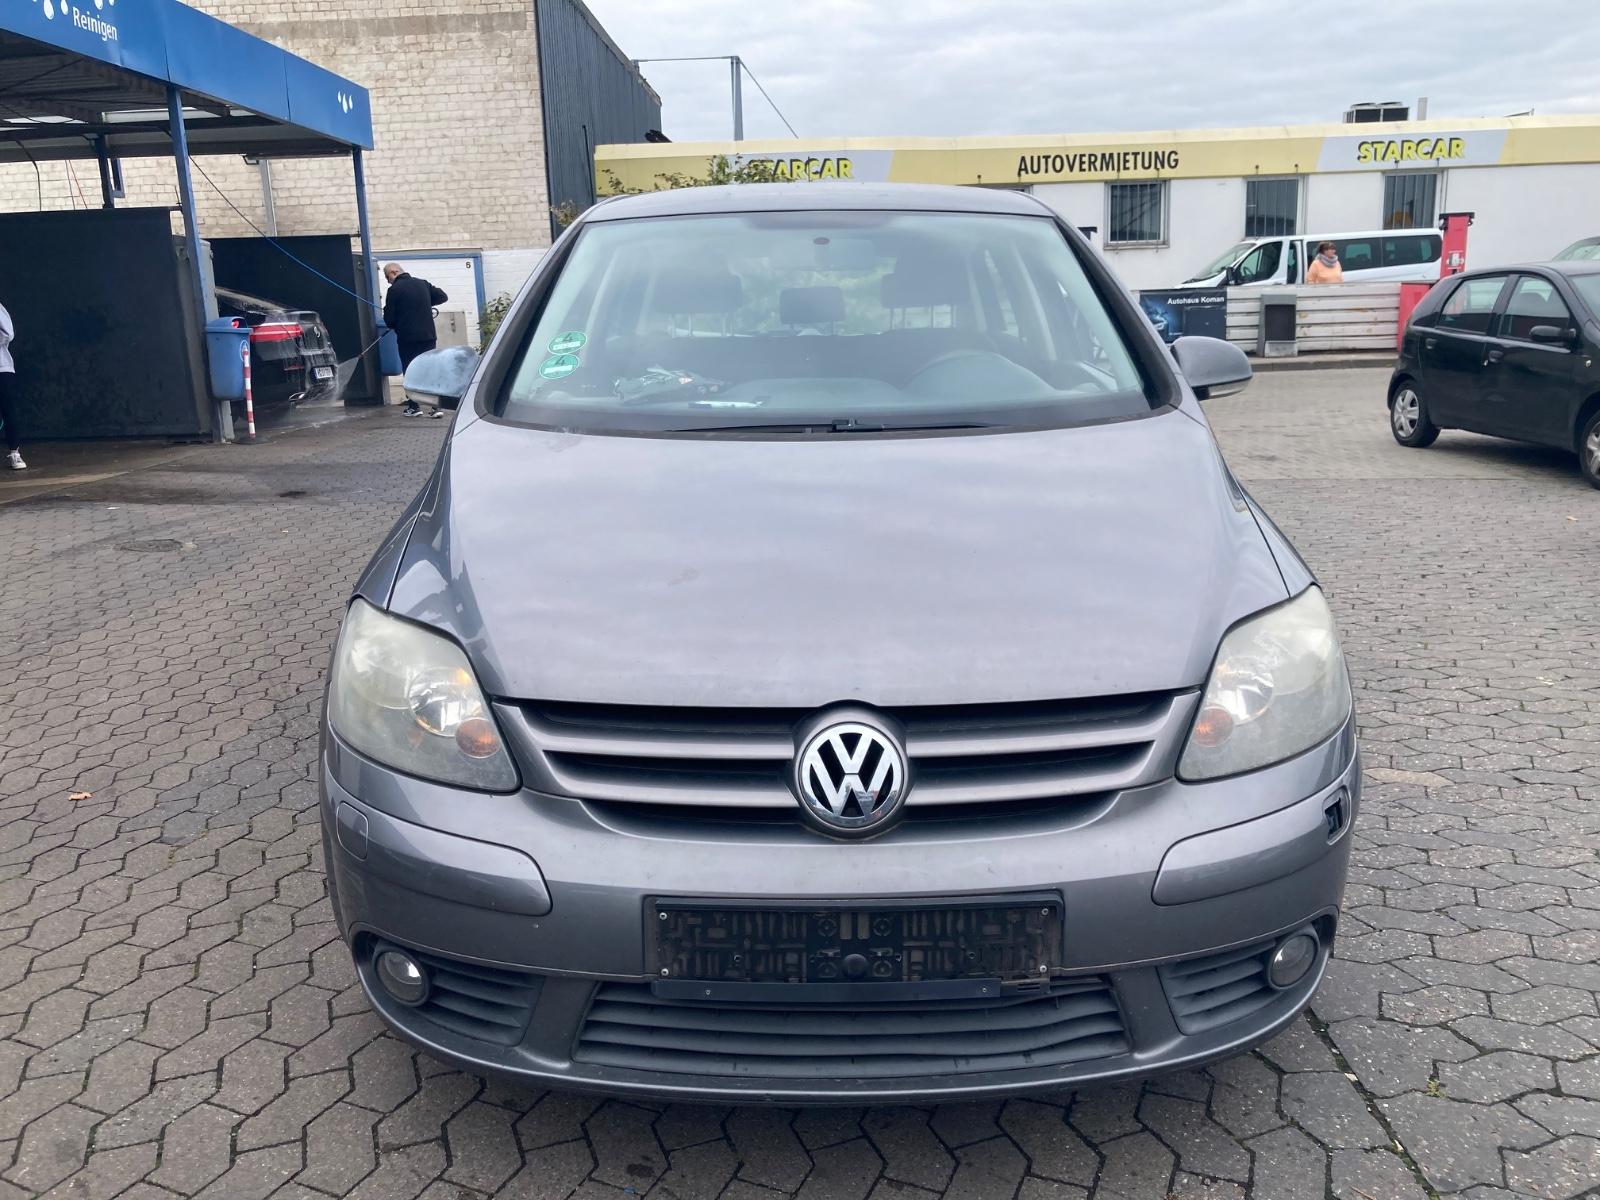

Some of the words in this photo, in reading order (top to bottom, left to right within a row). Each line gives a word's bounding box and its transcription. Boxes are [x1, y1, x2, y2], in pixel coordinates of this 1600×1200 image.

[73, 6, 118, 41] Reinigen
[1017, 150, 1180, 178] AUTOVERMIETUNG
[1357, 138, 1465, 161] STARCAR
[801, 724, 902, 830] VW
